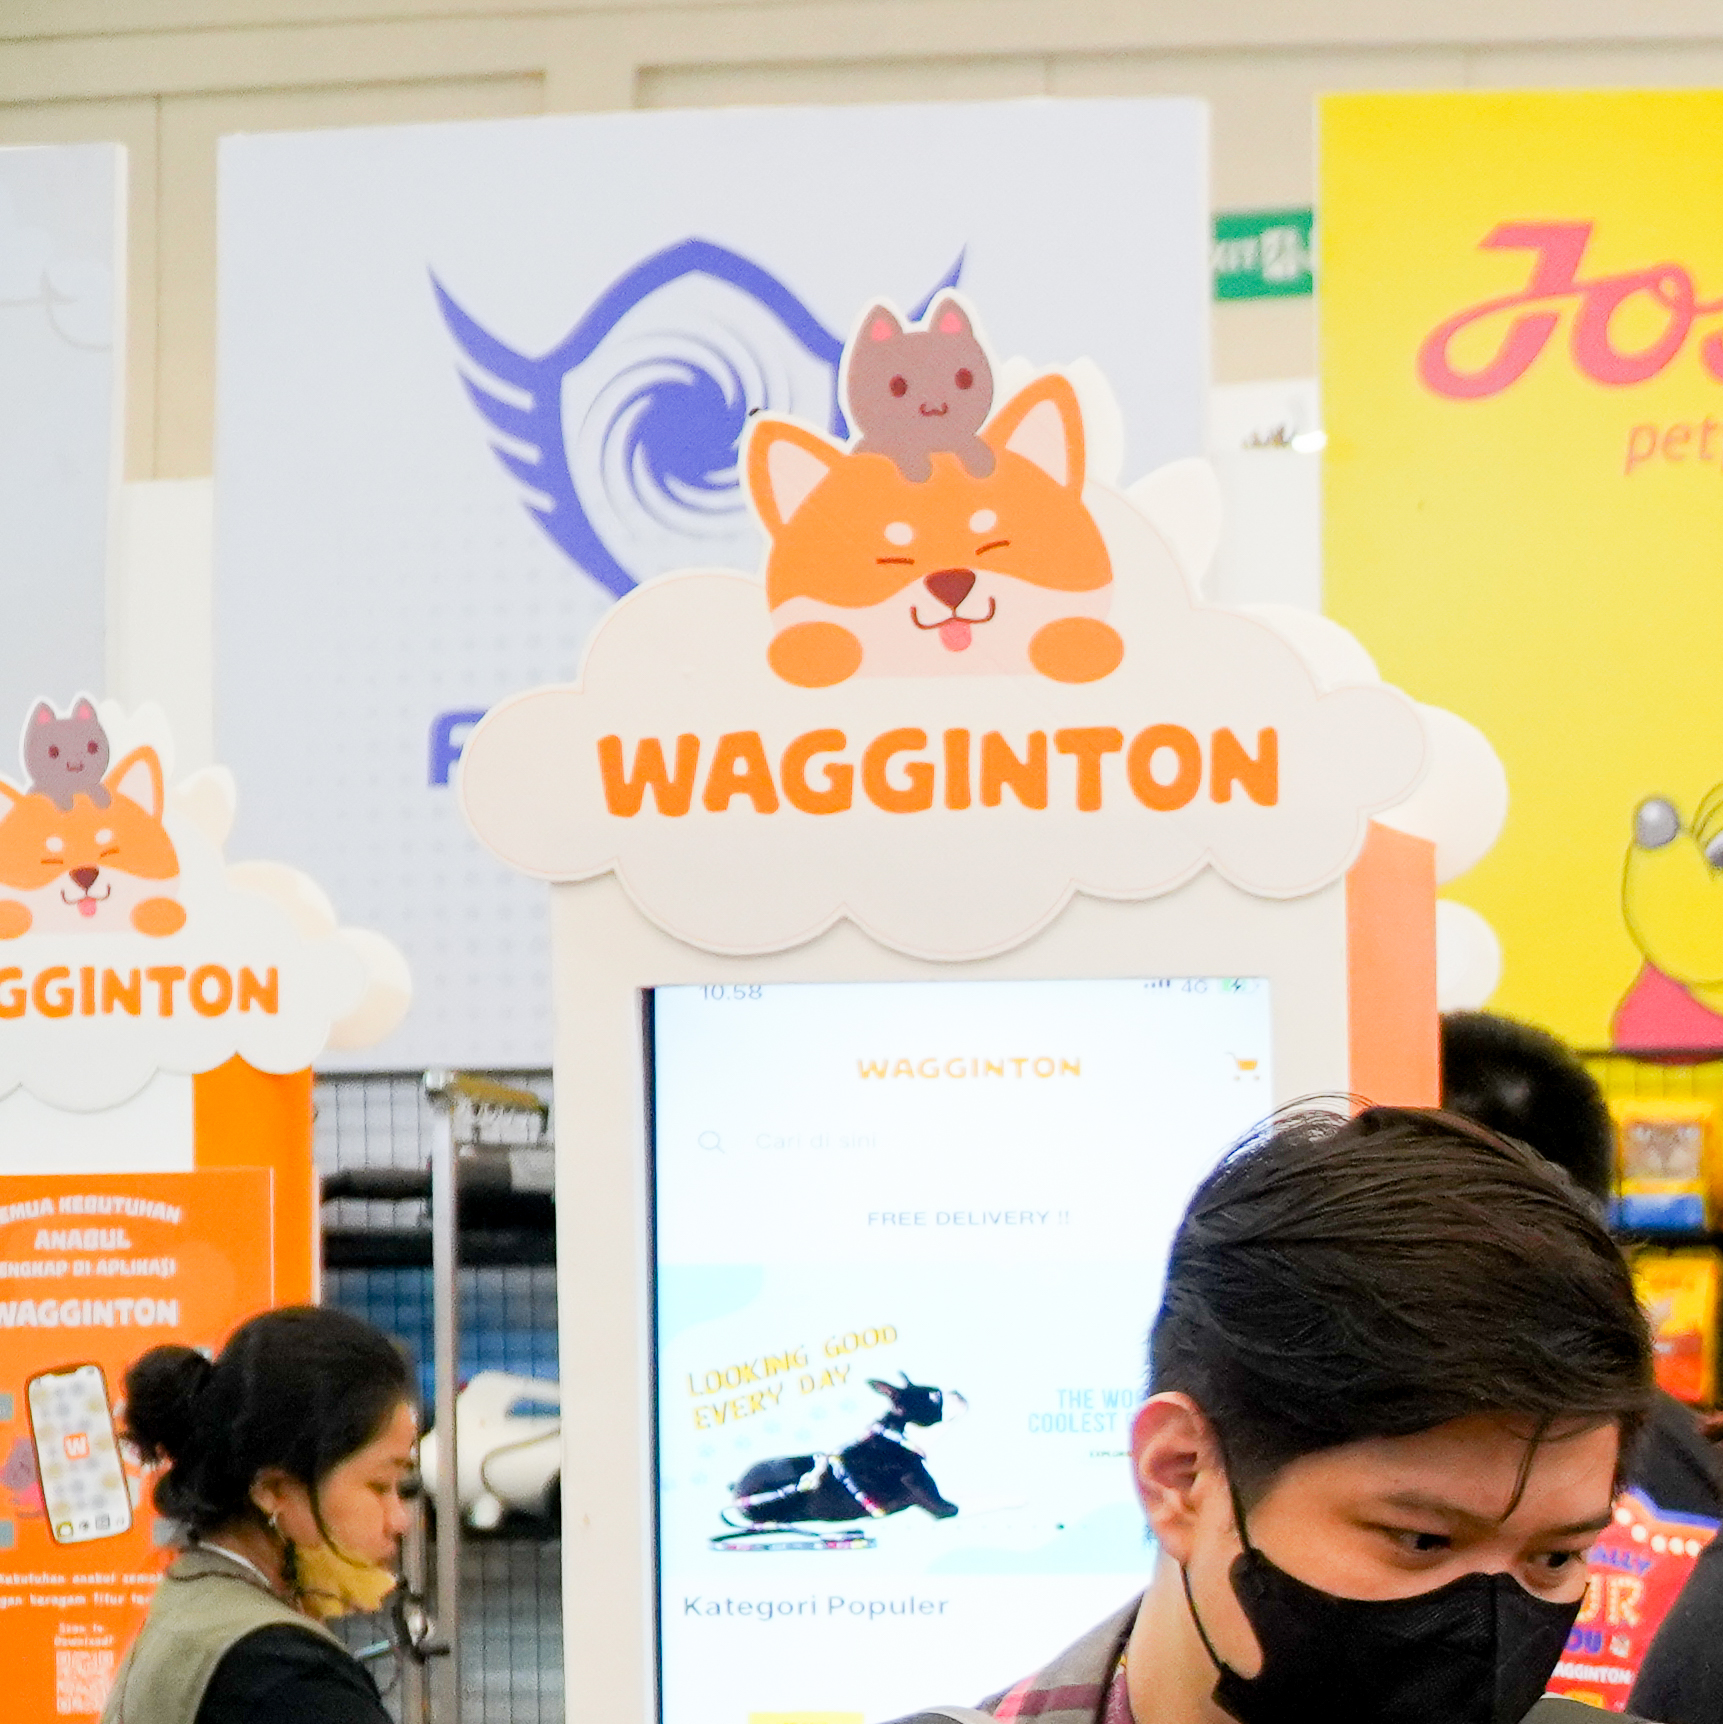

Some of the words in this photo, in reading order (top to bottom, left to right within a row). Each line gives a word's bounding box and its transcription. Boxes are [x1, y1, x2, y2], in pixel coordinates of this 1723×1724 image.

[598, 724, 1279, 817] WAGGINTON
[0, 964, 279, 1018] GGINTON
[700, 983, 764, 1001] 10.58
[856, 1056, 1082, 1080] WAGGINTON
[756, 1132, 801, 1150] Cari
[810, 1132, 830, 1149] di
[839, 1132, 877, 1149] sini
[0, 1196, 55, 1227] EMUA
[867, 1210, 927, 1226] FREE
[936, 1209, 1050, 1226] DELIVERY
[35, 1228, 132, 1251] ANABUL
[0, 1260, 68, 1279] NGKAP
[73, 1259, 91, 1277] DI
[687, 1346, 808, 1398] LOOKING
[824, 1324, 898, 1359] GOOD
[695, 1381, 783, 1430] EVERY
[800, 1362, 852, 1395] DAY
[1057, 1388, 1094, 1409] THE
[1028, 1412, 1117, 1433] COOLEST
[0, 1572, 66, 1584] ebutuhan
[683, 1595, 817, 1621] Kategori
[829, 1595, 950, 1621] Populer
[1577, 1573, 1643, 1627] UR
[1553, 1662, 1634, 1685] AGGINTON
